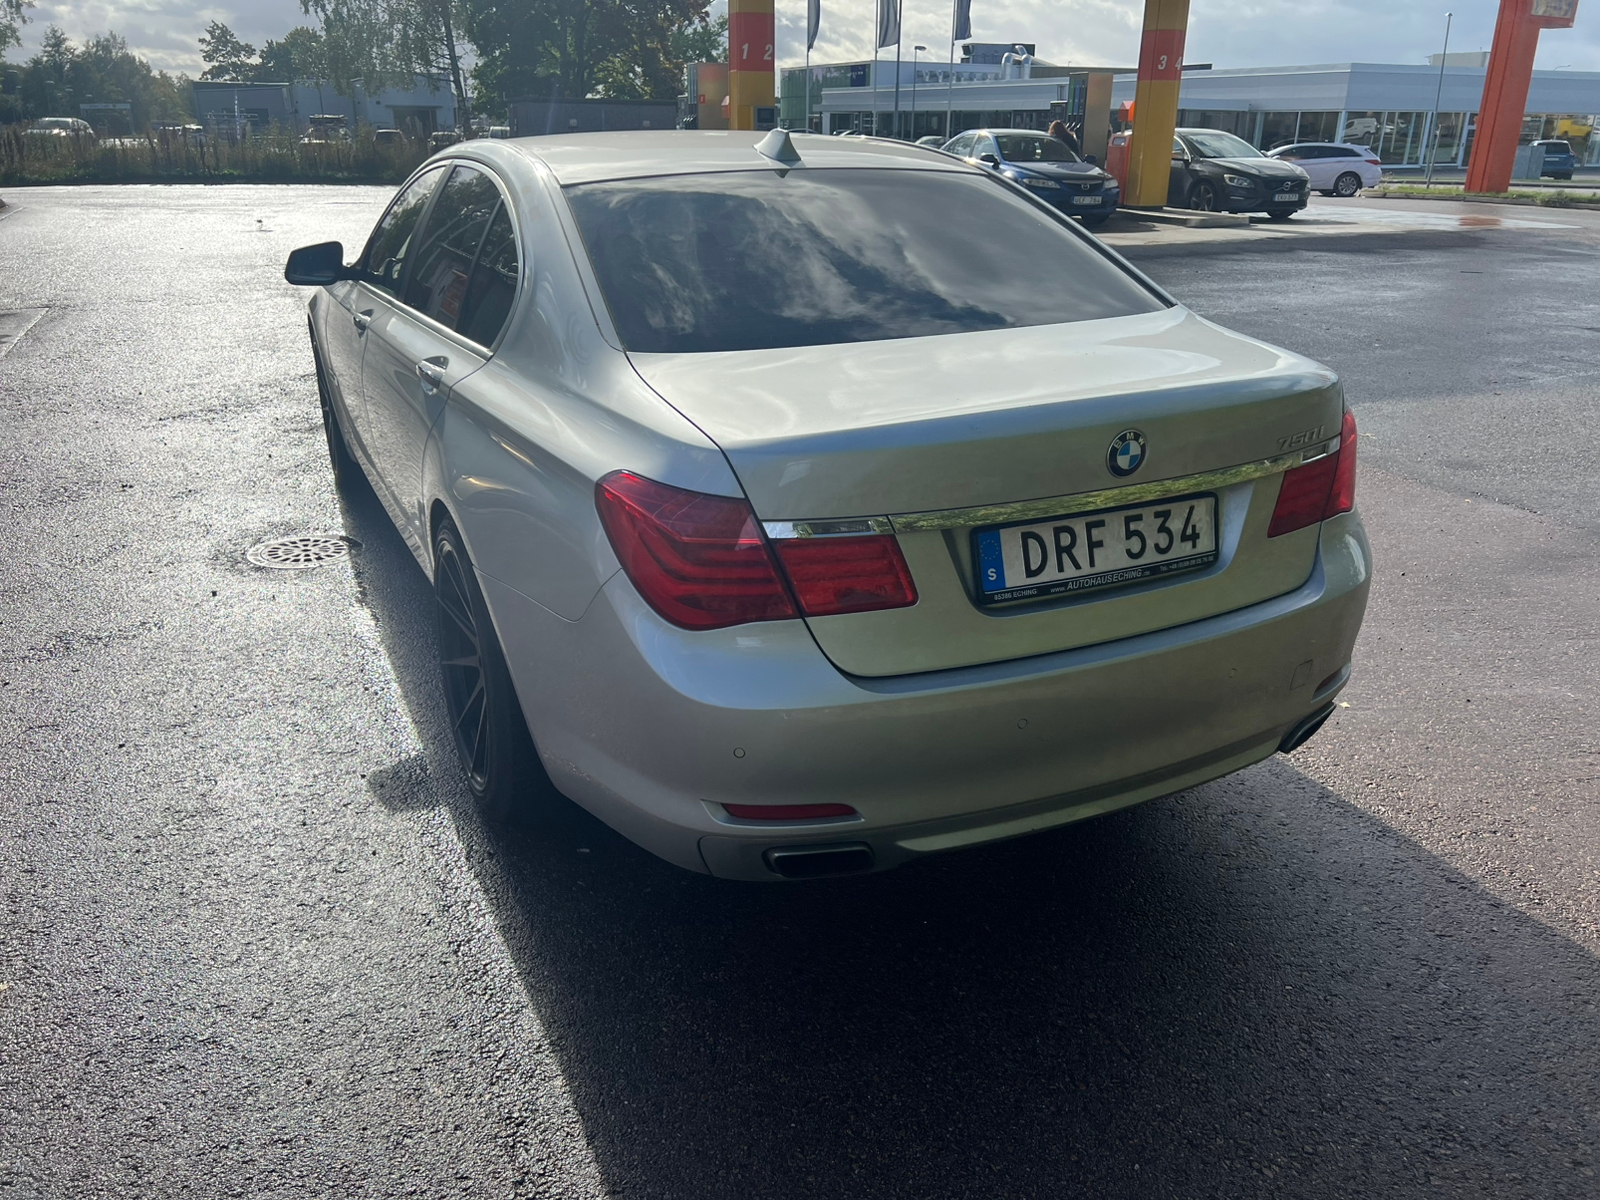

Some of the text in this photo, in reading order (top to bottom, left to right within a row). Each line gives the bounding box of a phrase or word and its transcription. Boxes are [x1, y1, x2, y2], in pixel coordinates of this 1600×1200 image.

[741, 43, 773, 60] 1 2
[1157, 54, 1182, 71] 3 4
[1113, 431, 1145, 449] BMW
[1020, 504, 1200, 579] DRF 534
[987, 567, 997, 581] S
[1013, 588, 1038, 598] ECHING
